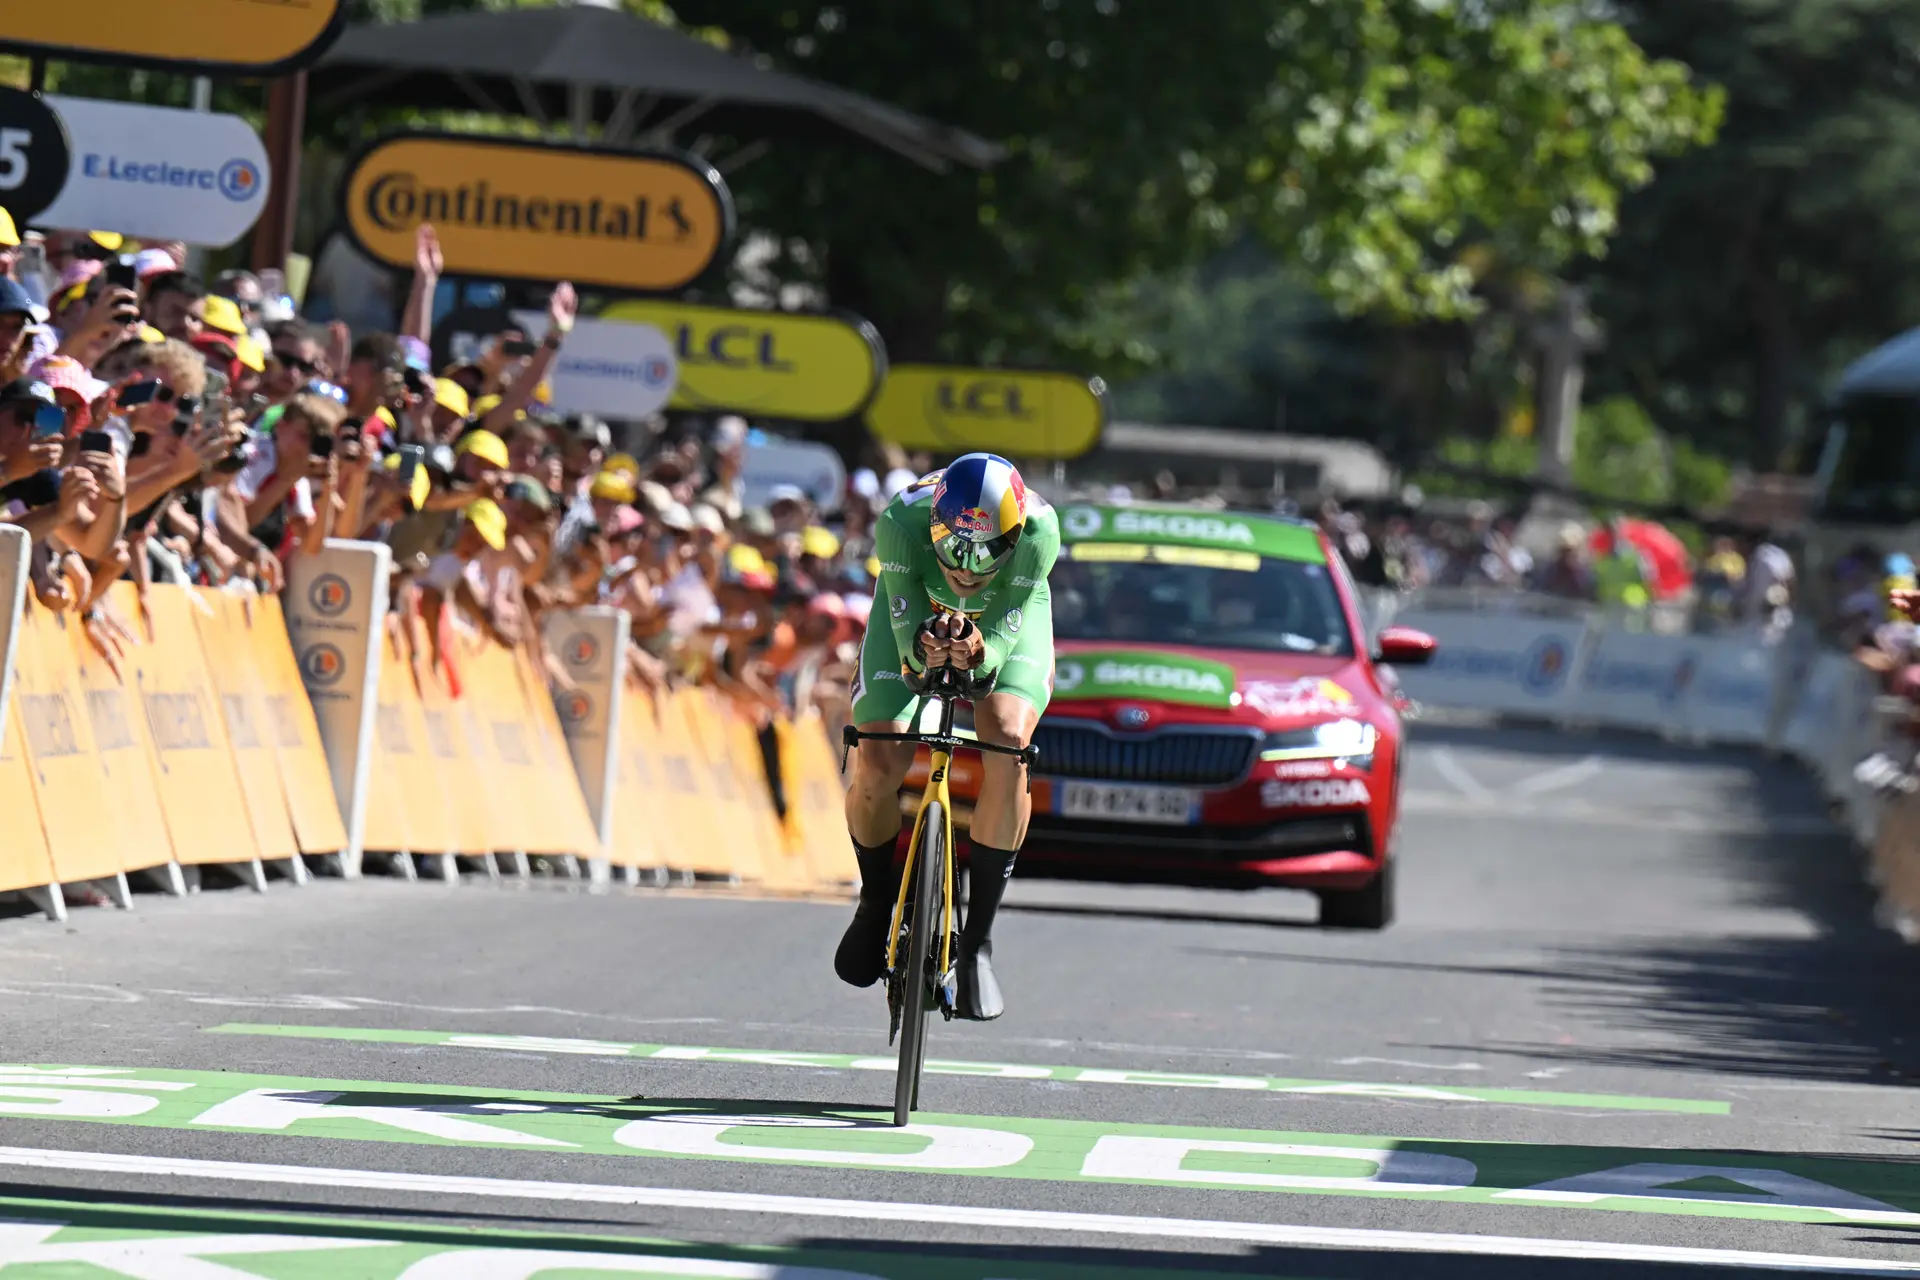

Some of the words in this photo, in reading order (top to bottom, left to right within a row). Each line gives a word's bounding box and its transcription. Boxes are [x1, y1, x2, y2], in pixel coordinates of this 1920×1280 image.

[366, 170, 648, 240] Continental
[677, 322, 792, 371] LCL
[938, 379, 1033, 420] LCL
[955, 515, 974, 529] Red
[975, 521, 993, 533] Bull
